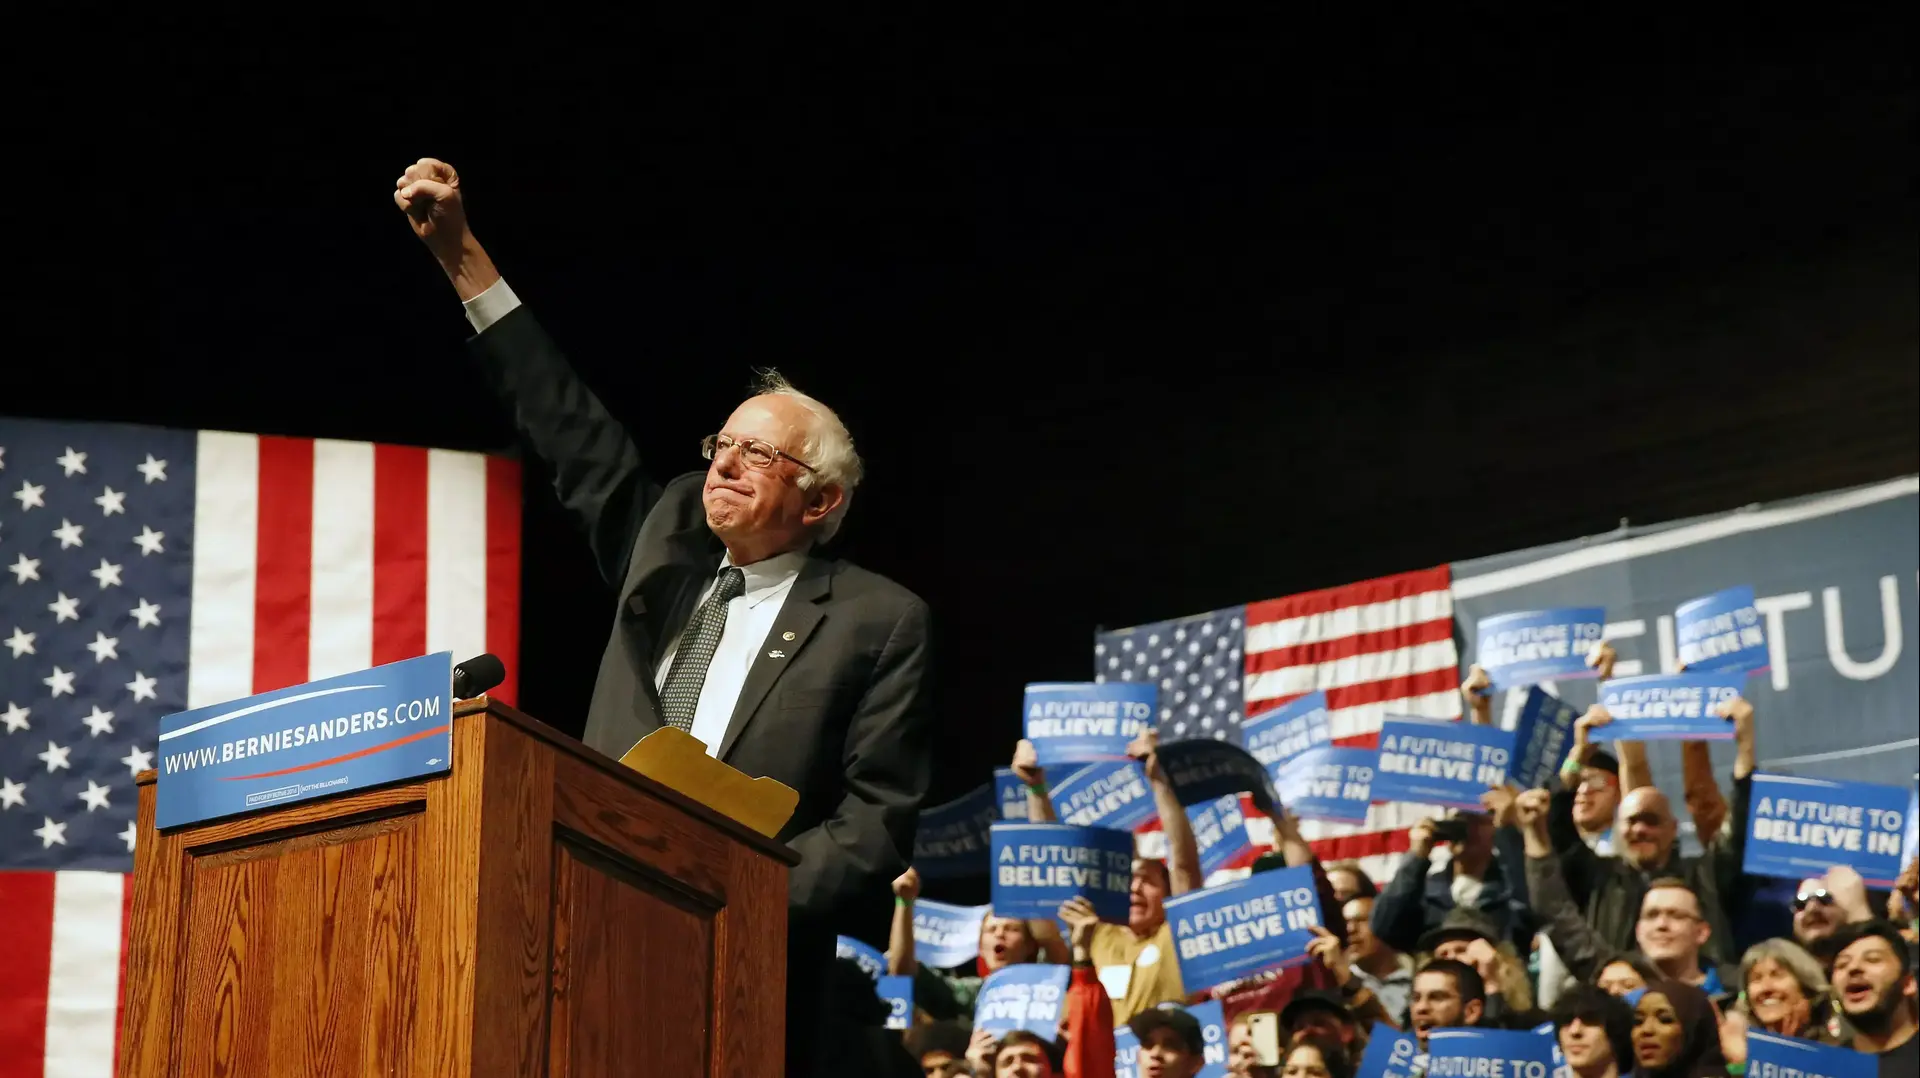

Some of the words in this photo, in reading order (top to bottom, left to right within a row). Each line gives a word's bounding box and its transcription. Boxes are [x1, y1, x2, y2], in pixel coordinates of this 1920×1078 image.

[1573, 622, 1601, 640] TO
[1620, 686, 1703, 704] FUTURE
[1707, 686, 1739, 701] TO
[1028, 702, 1043, 718] A
[1044, 701, 1119, 719] FUTURE
[1121, 701, 1151, 720] TO
[164, 695, 441, 775] WWW.BERNIESANDERS.COM
[1026, 717, 1117, 739] BELIEVE
[1382, 734, 1398, 751] A
[1399, 735, 1476, 762] FUTURE
[1480, 745, 1509, 766] TO
[1347, 765, 1374, 783] TO
[1378, 752, 1475, 782] BELIEVE
[1476, 764, 1506, 787] IN
[1059, 801, 1074, 818] A
[1070, 763, 1139, 809] FUTURE
[1343, 781, 1371, 801] IN
[1755, 796, 1774, 817] A
[1775, 798, 1865, 827] FUTURE
[1866, 808, 1903, 831] TO
[1753, 817, 1864, 851] BELIEVE
[1867, 831, 1901, 856] IN
[999, 845, 1016, 864] A
[1018, 845, 1100, 866] FUTURE
[1104, 851, 1130, 871] TO
[998, 865, 1102, 889] BELIEVE
[1106, 872, 1130, 893] IN
[1177, 918, 1194, 938] A
[1193, 894, 1279, 932] FUTURE
[1279, 887, 1313, 909] TO
[1180, 914, 1286, 960] BELIEVE
[1286, 906, 1318, 932] IN
[1439, 1056, 1505, 1078] FUTURE
[1508, 1060, 1547, 1078] TO
